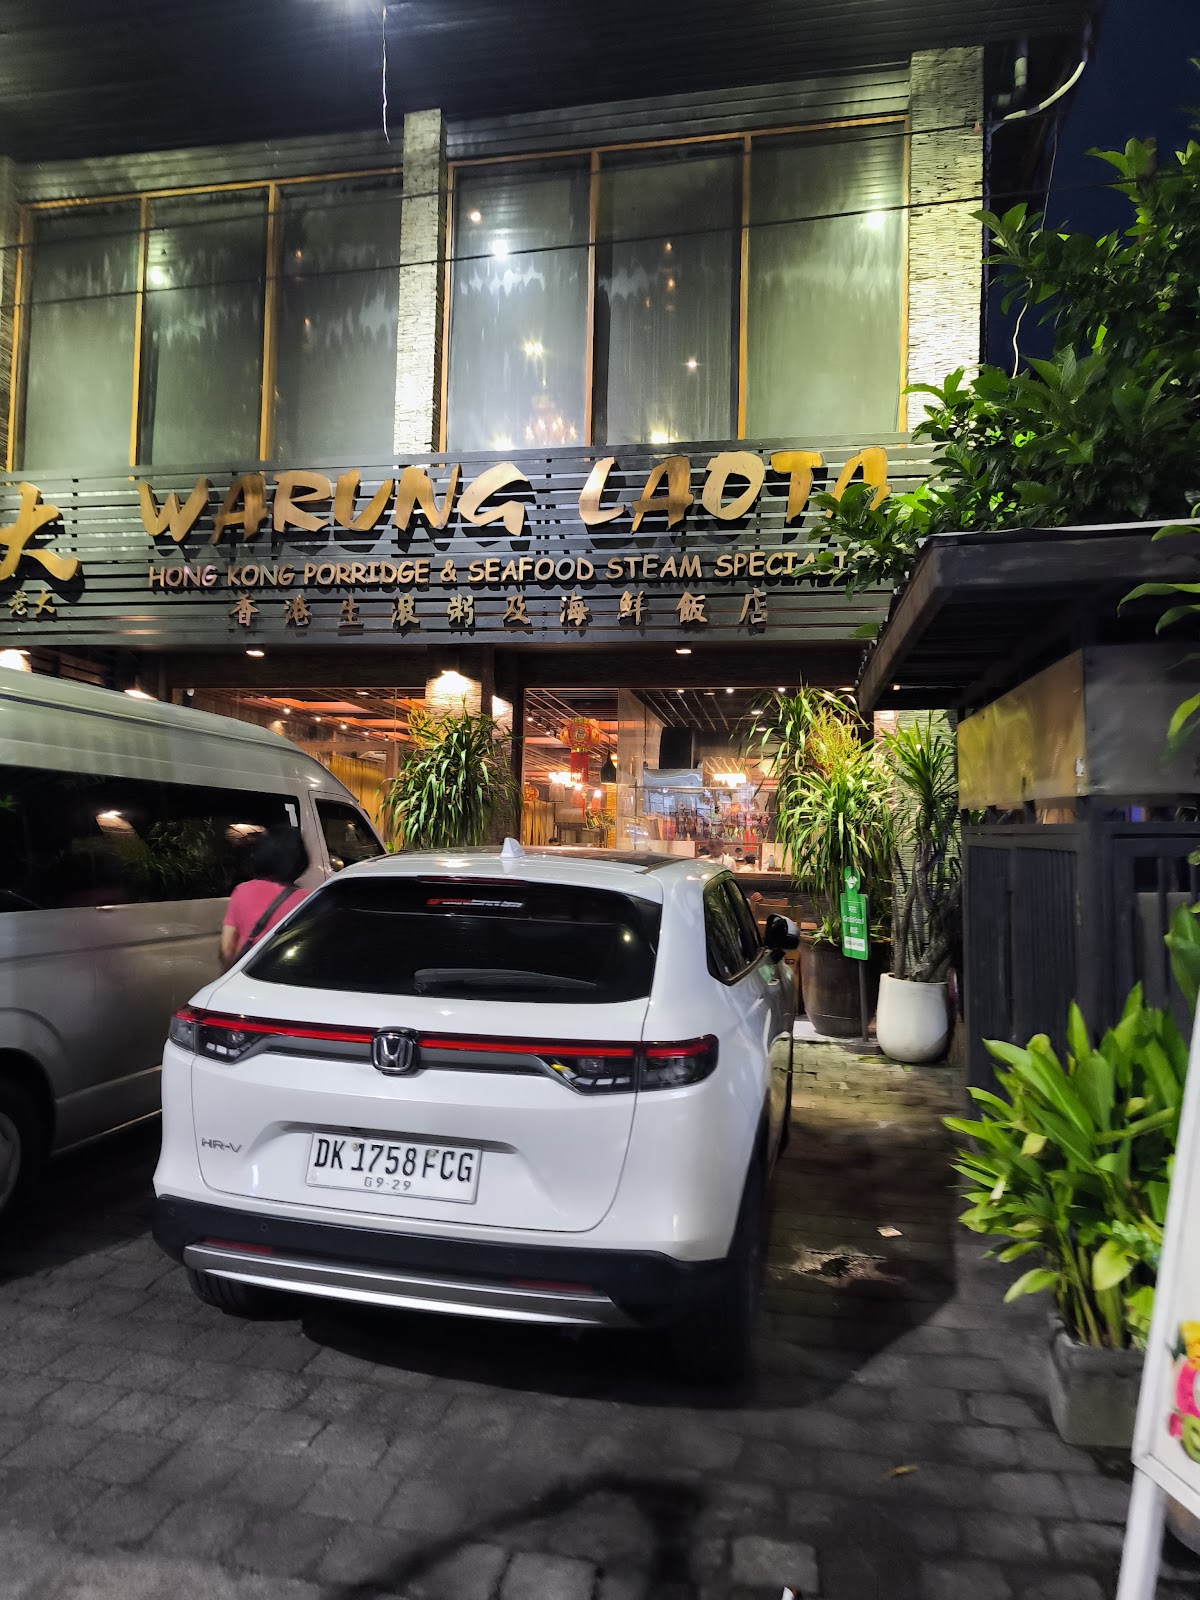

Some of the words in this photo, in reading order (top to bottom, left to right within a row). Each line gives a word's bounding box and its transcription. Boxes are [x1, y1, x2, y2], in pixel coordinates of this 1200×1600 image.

[137, 463, 529, 544] WARUNG
[578, 446, 892, 534] LAOTA
[148, 565, 218, 587] HONG
[227, 565, 296, 586] KONG
[303, 560, 430, 585] PORRIDGE
[440, 561, 457, 582] &
[467, 555, 595, 582] SEAFOOD
[605, 554, 703, 578] STEAM
[201, 1137, 242, 1153] HR-V
[314, 1138, 346, 1169] DK
[351, 1143, 417, 1177] 1758
[422, 1149, 474, 1183] FCG
